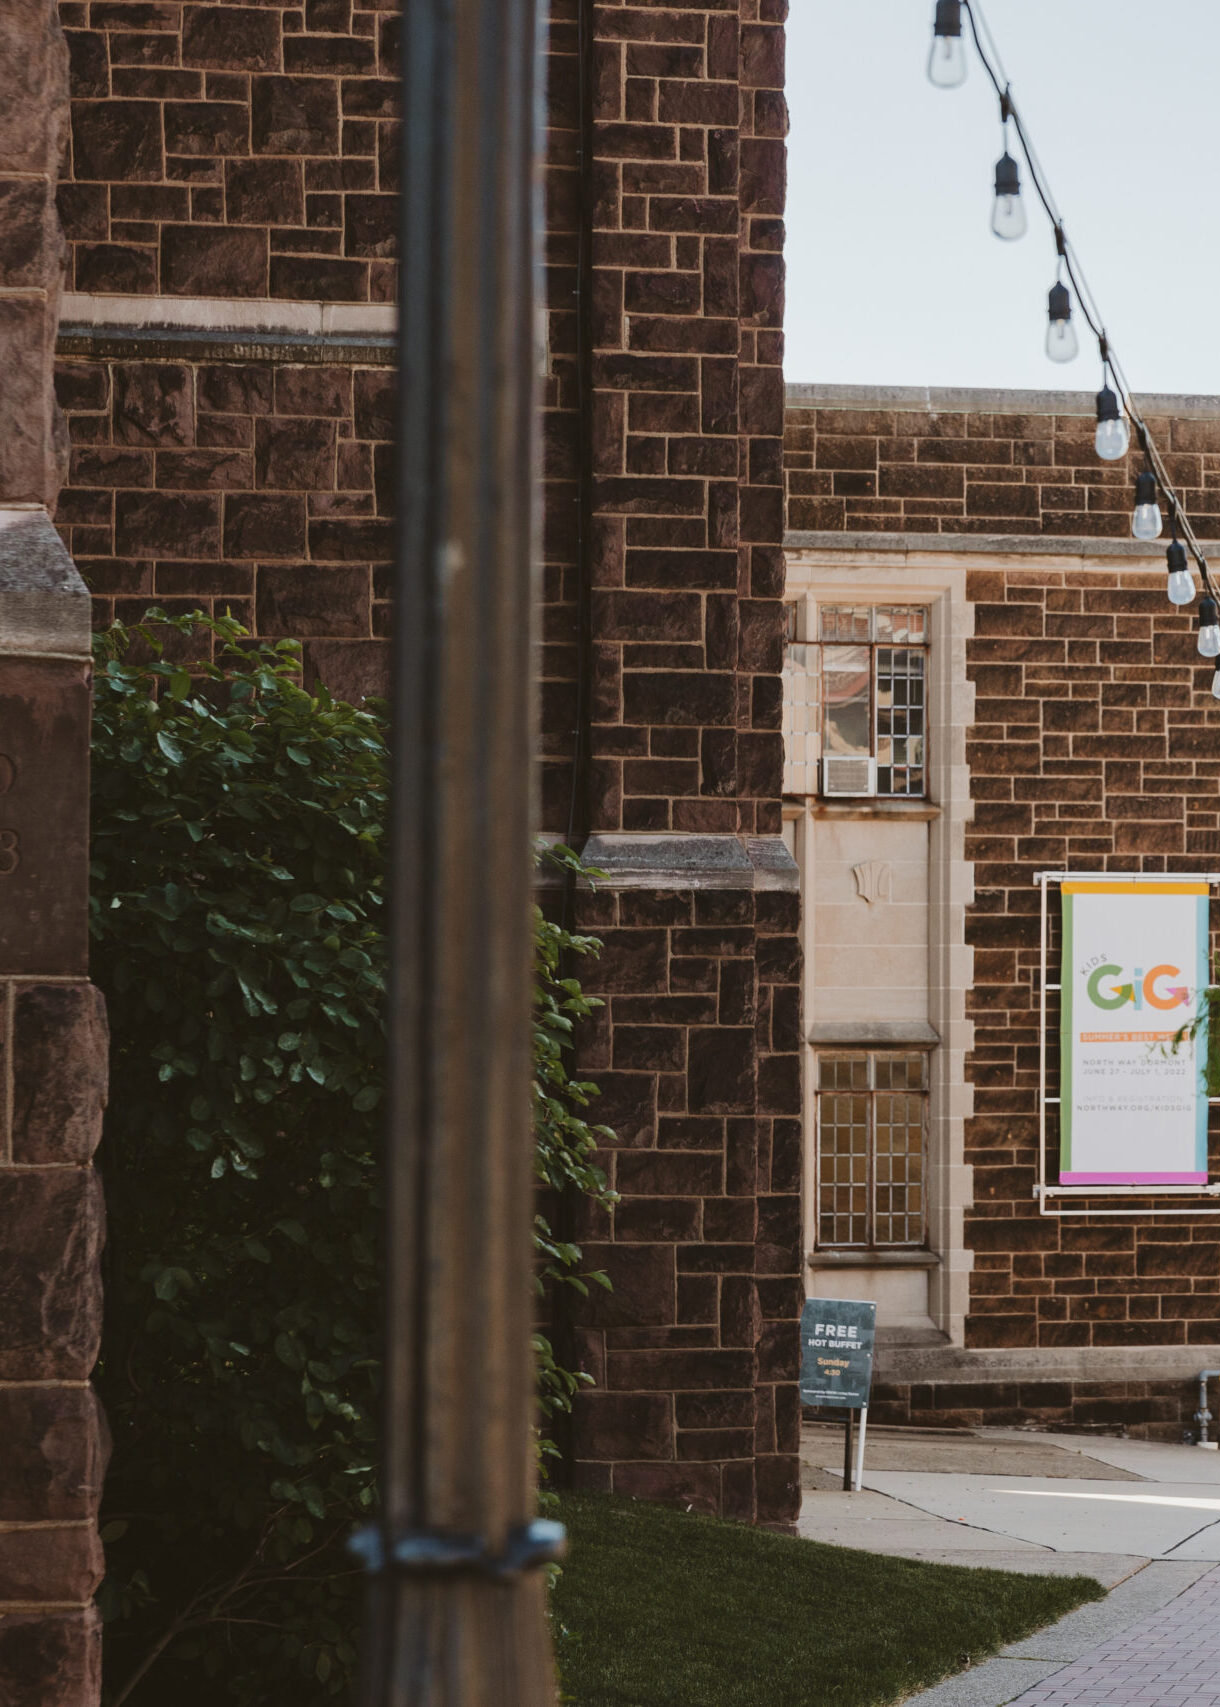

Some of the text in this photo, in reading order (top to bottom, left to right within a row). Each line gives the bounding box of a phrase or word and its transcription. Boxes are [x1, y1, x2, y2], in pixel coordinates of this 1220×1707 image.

[1080, 953, 1107, 976] KIDS
[1082, 1068, 1106, 1076] JUNE
[1130, 1068, 1151, 1076] JULY
[1164, 1068, 1186, 1076] 2022
[815, 1324, 857, 1338] FREE
[808, 1339, 862, 1349] HOT BUFFET
[817, 1357, 849, 1368] Sunday
